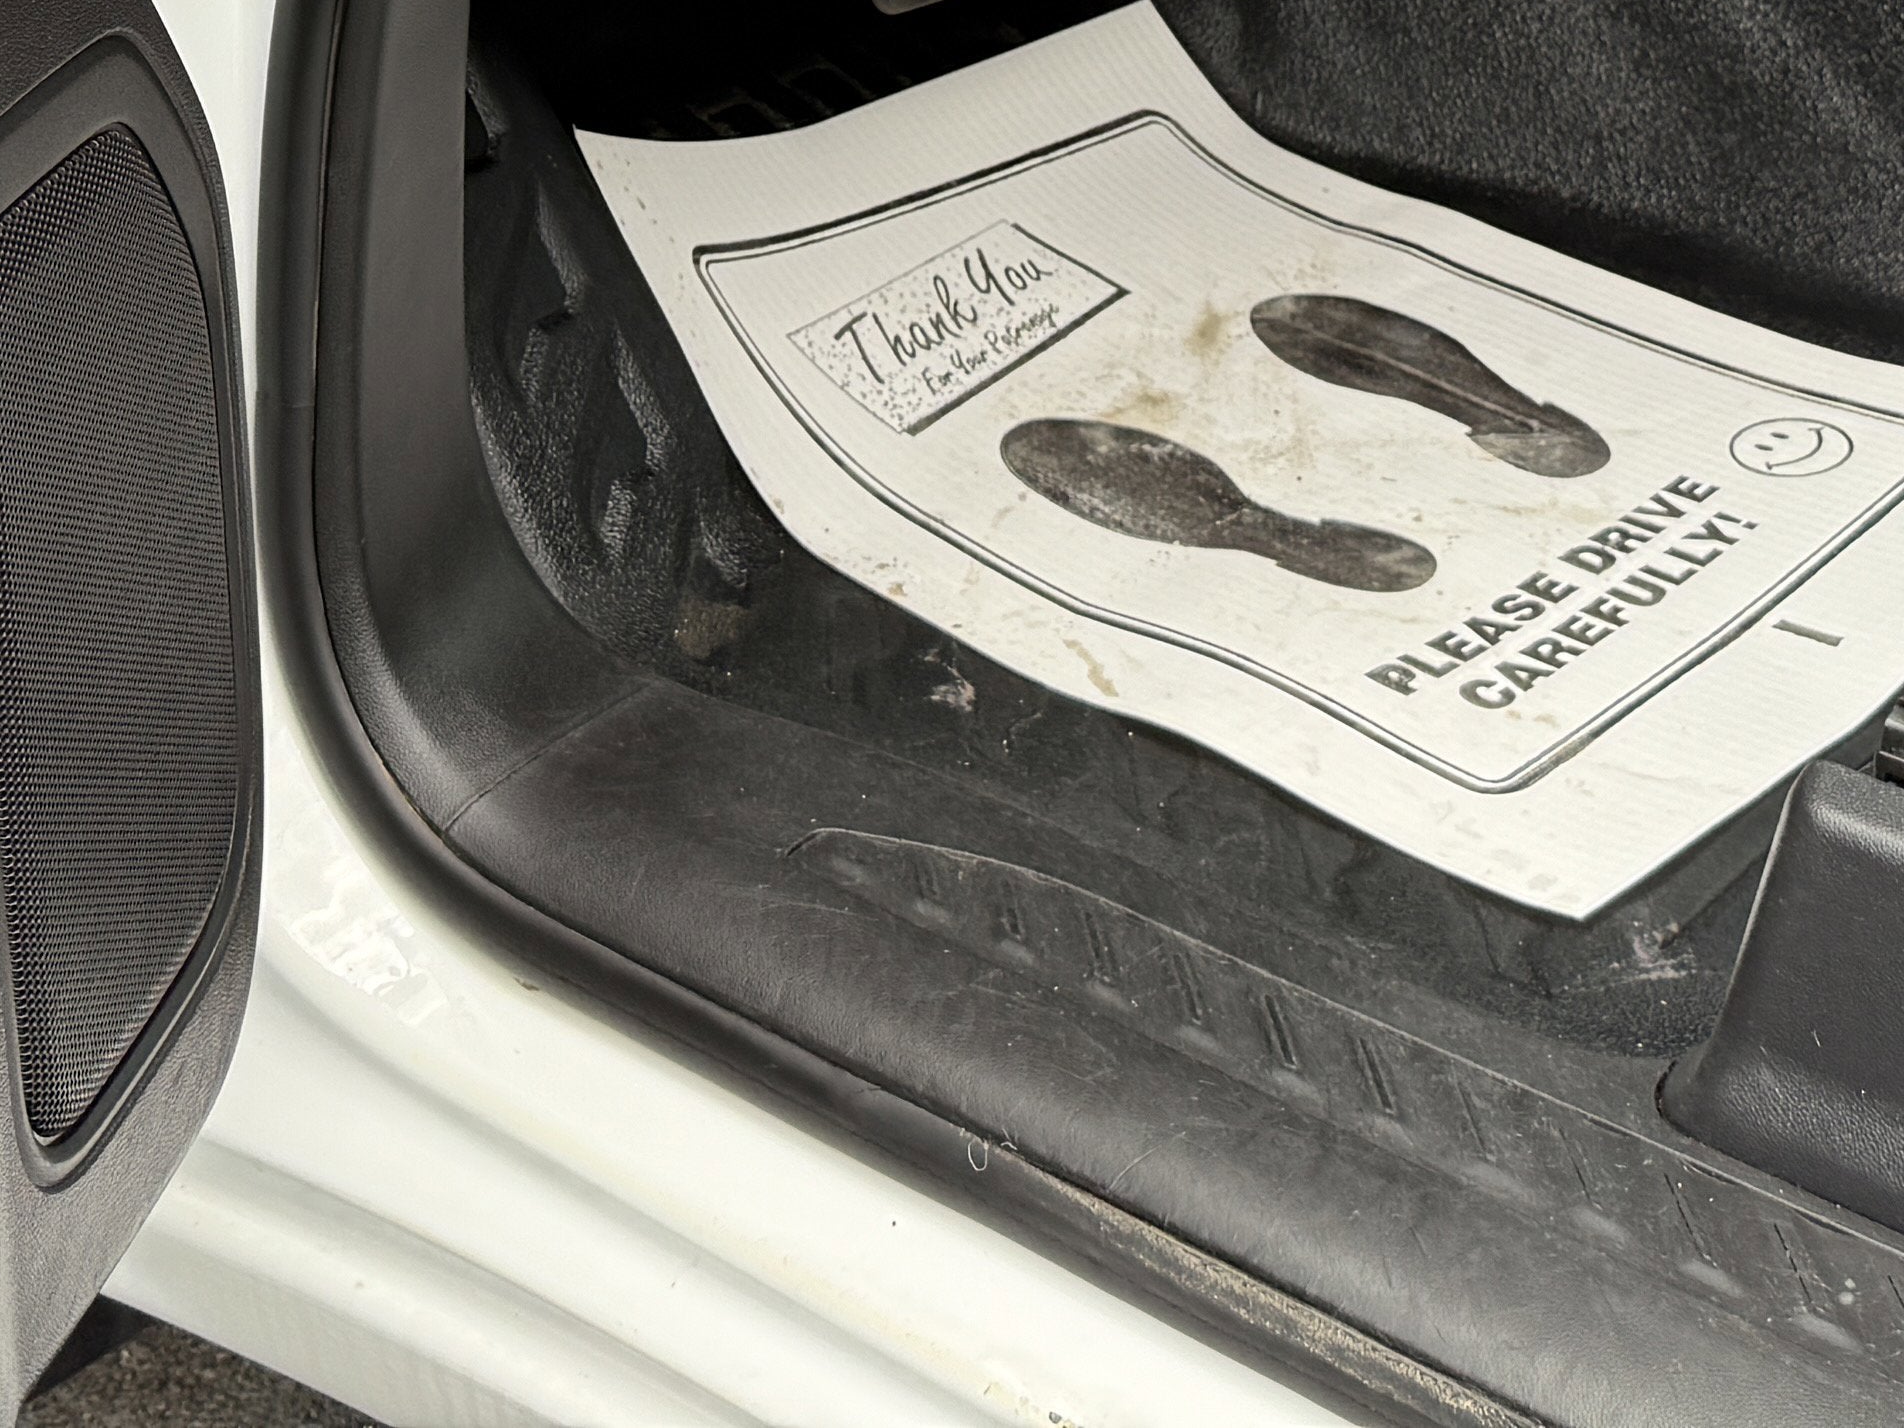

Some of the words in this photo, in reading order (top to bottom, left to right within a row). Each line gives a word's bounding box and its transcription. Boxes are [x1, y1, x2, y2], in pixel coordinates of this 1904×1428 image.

[834, 274, 979, 384] Thank
[963, 247, 1053, 306] You
[921, 366, 955, 395] For
[950, 349, 988, 375] Your
[1363, 569, 1581, 696] PLEASE
[1556, 474, 1721, 576] DRIVE
[1458, 511, 1760, 710] CAREFULLY!
